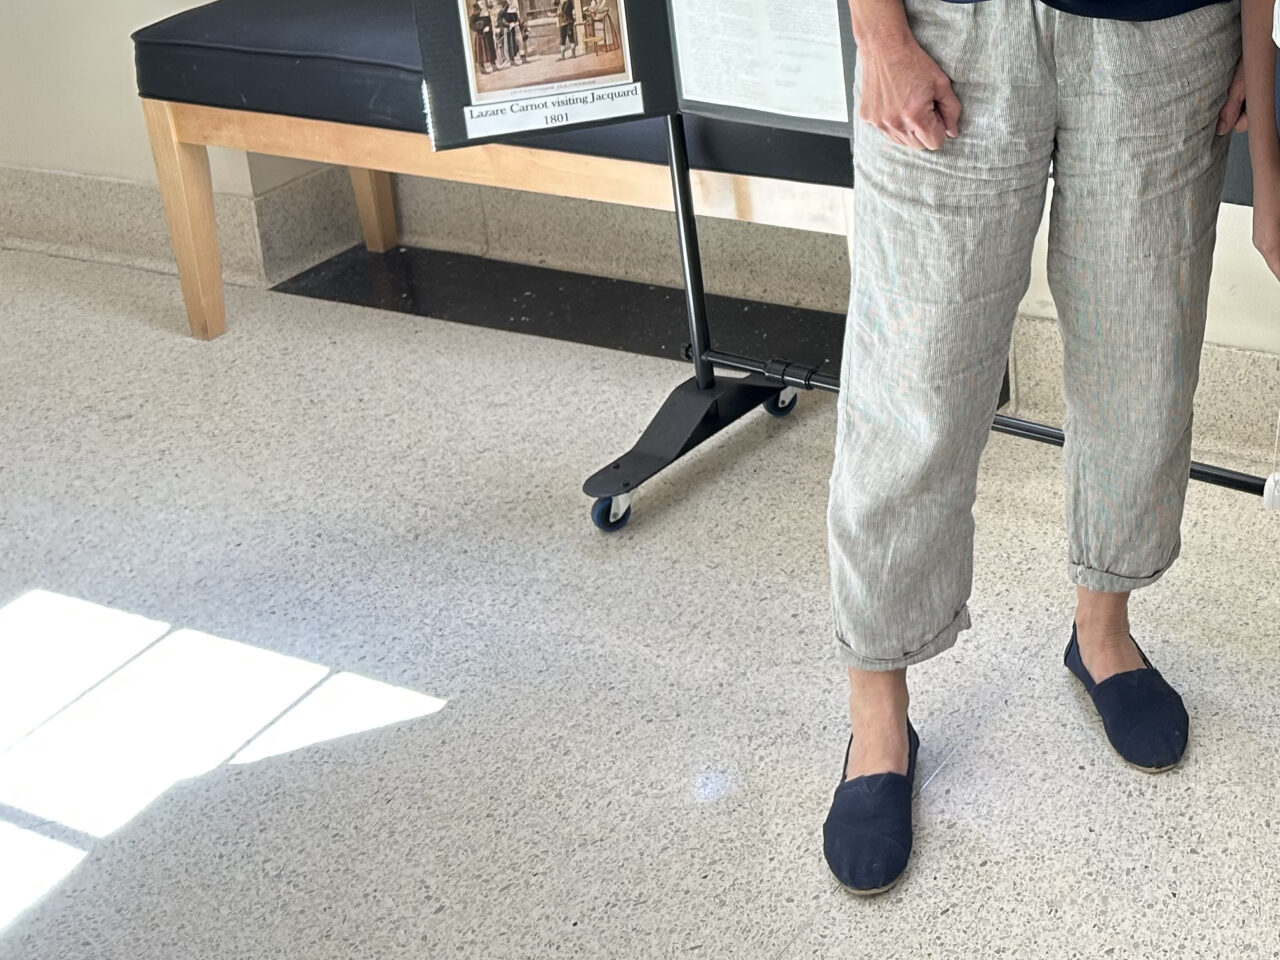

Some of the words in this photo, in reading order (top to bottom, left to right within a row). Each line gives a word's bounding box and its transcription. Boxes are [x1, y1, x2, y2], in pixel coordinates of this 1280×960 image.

[469, 106, 507, 120] Lazare
[510, 100, 549, 113] Carnot
[551, 94, 588, 107] visiting
[590, 87, 638, 103] Jacquard
[544, 112, 570, 125] 1801
